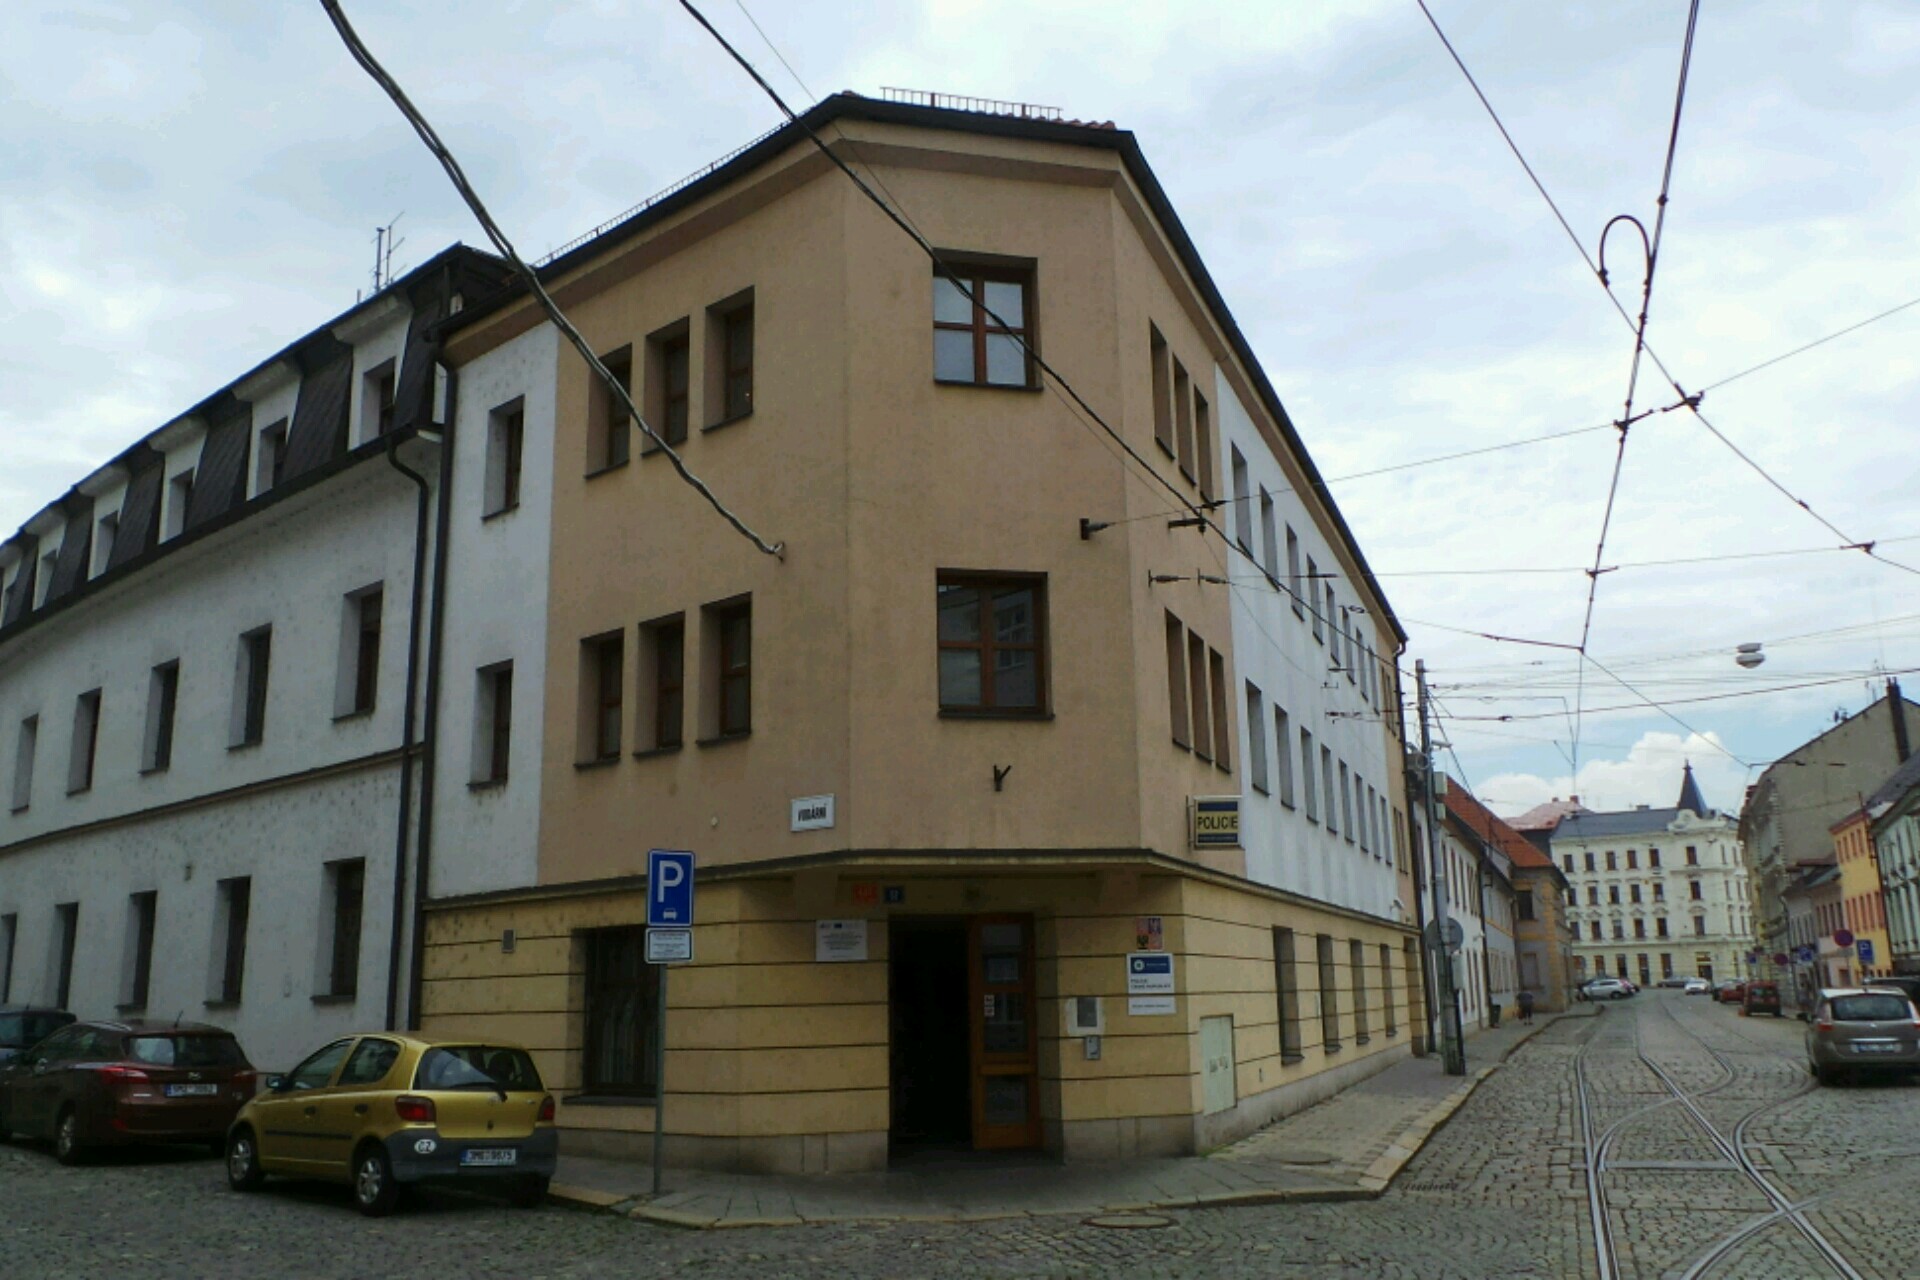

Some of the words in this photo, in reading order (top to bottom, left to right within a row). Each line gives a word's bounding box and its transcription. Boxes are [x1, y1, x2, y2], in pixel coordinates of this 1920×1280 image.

[1197, 815, 1239, 830] POLICIE
[657, 860, 684, 903] P
[418, 1141, 431, 1152] CZ
